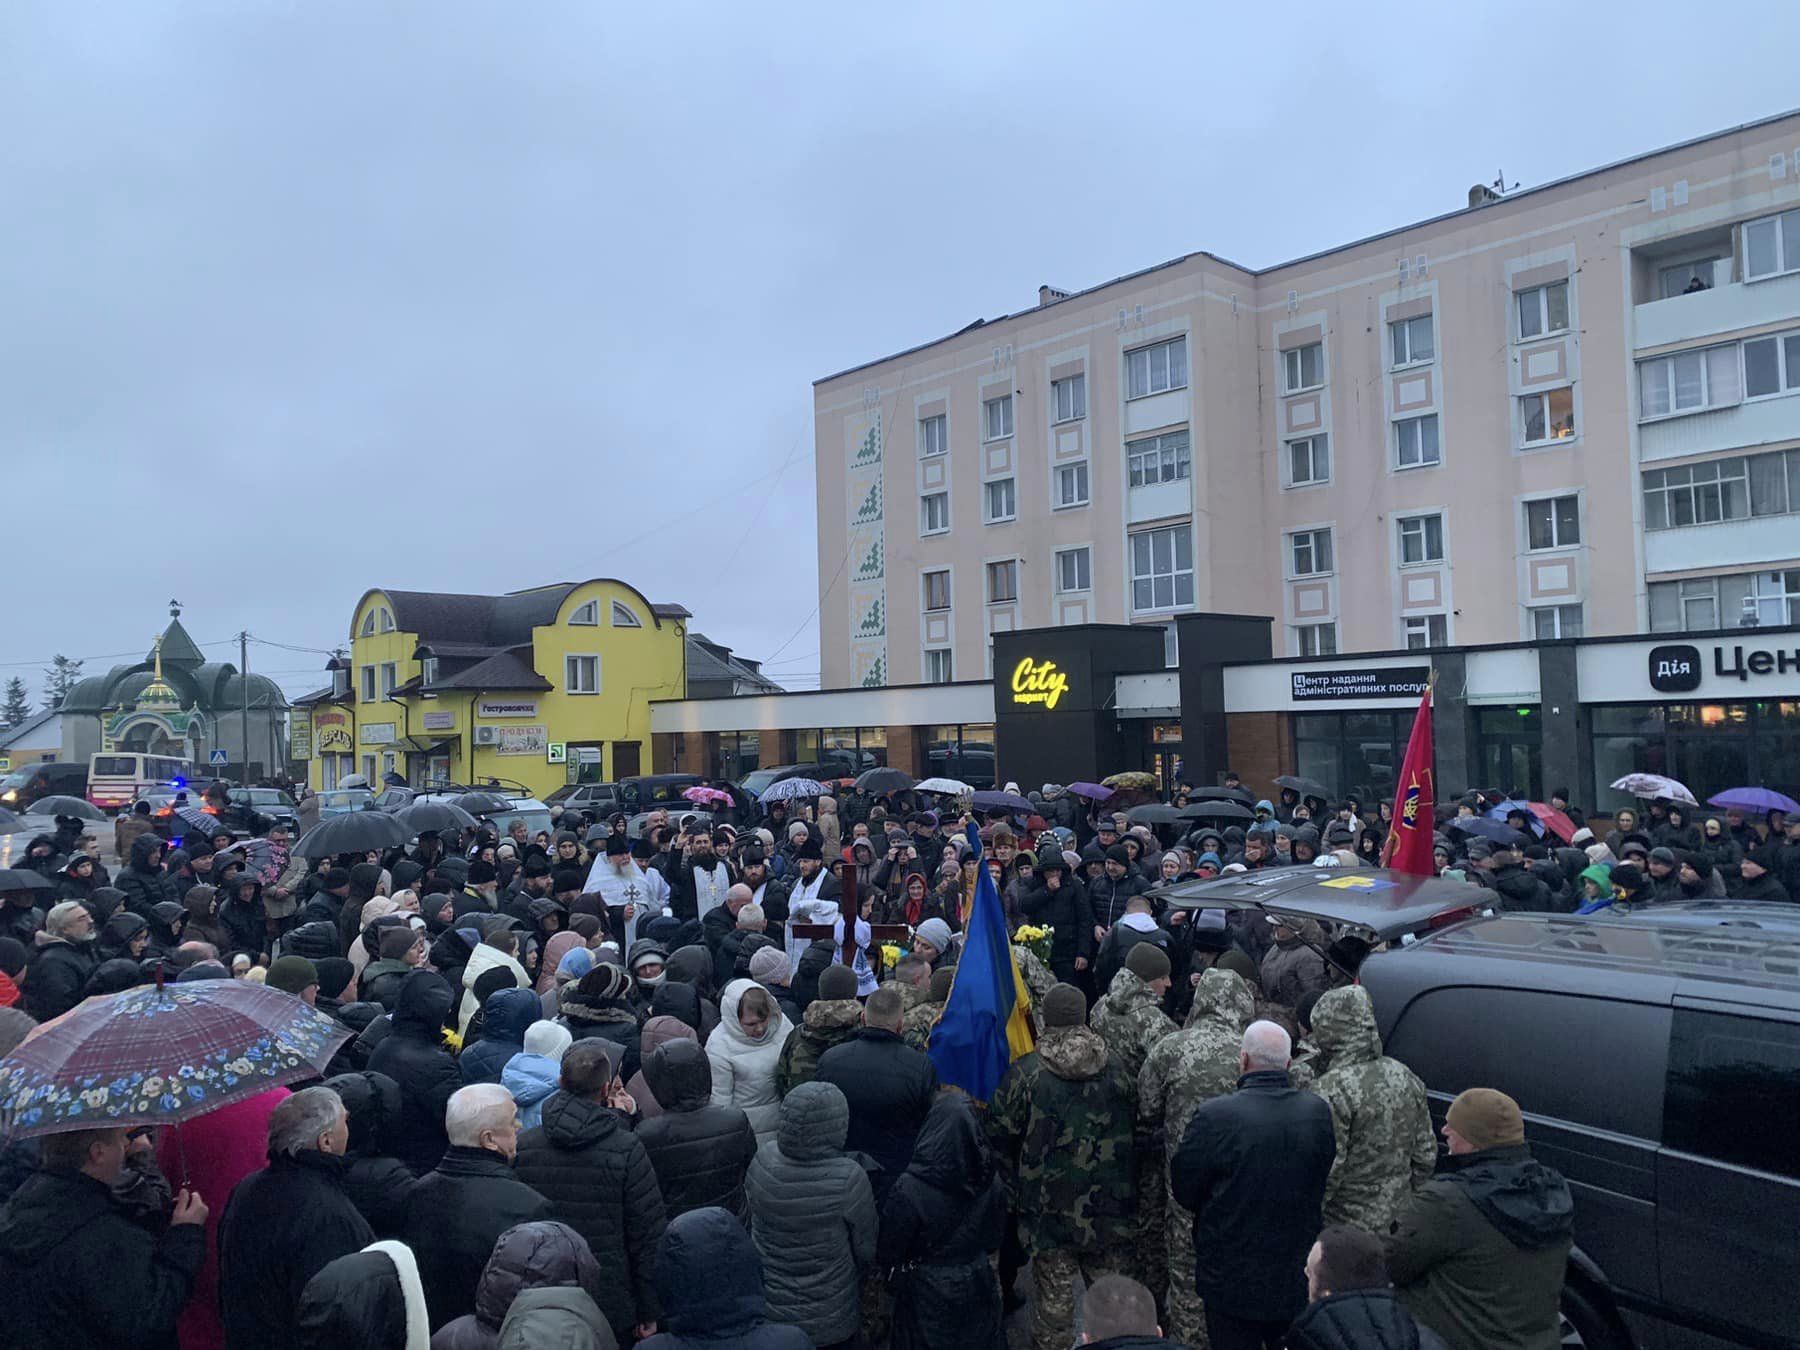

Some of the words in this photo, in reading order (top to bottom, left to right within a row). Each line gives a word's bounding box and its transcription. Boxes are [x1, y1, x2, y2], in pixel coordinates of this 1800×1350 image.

[1657, 659, 1690, 678] Дія
[1012, 657, 1069, 709] City
[1293, 674, 1330, 688] Центр
[1332, 674, 1376, 685] надання
[1294, 684, 1387, 696] адміністративних
